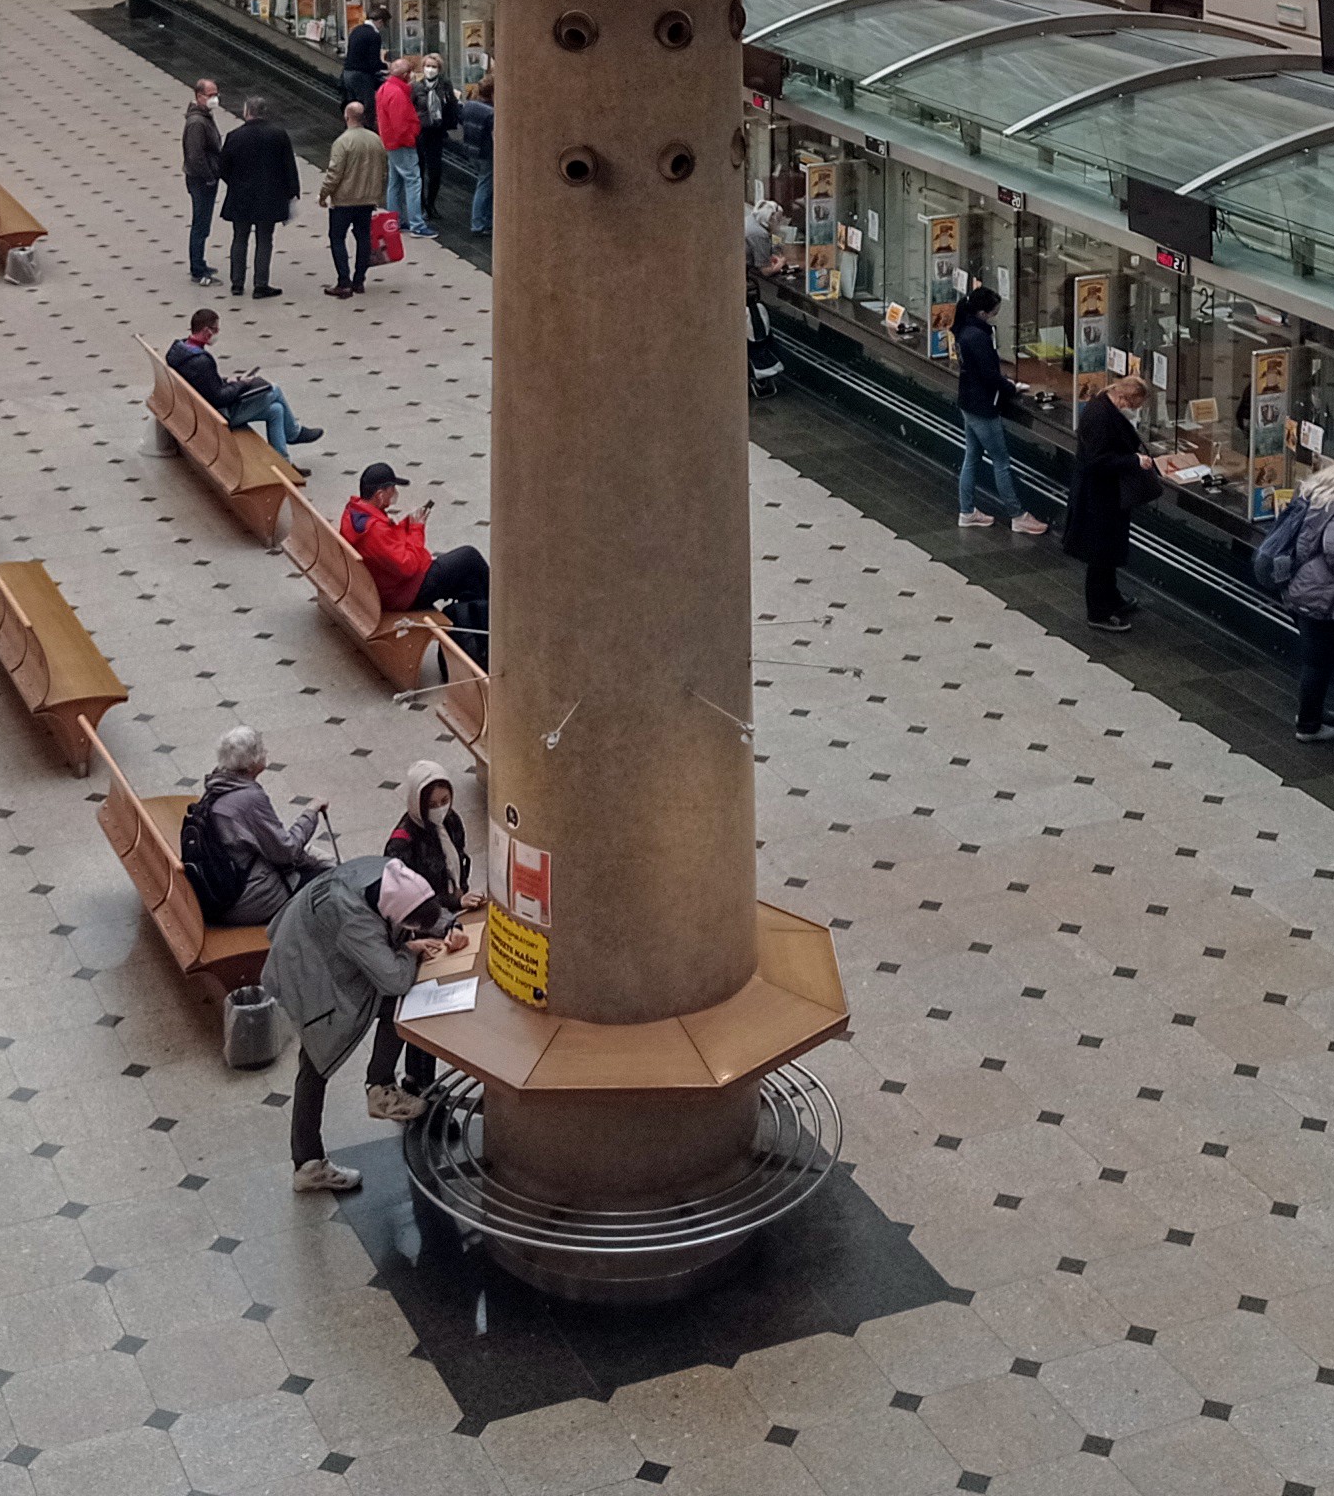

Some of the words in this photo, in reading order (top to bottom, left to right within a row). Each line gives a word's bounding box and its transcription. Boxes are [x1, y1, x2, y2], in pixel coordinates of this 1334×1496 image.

[1012, 195, 1021, 208] 20
[1173, 257, 1185, 272] 21
[514, 949, 539, 967] NAŠIM
